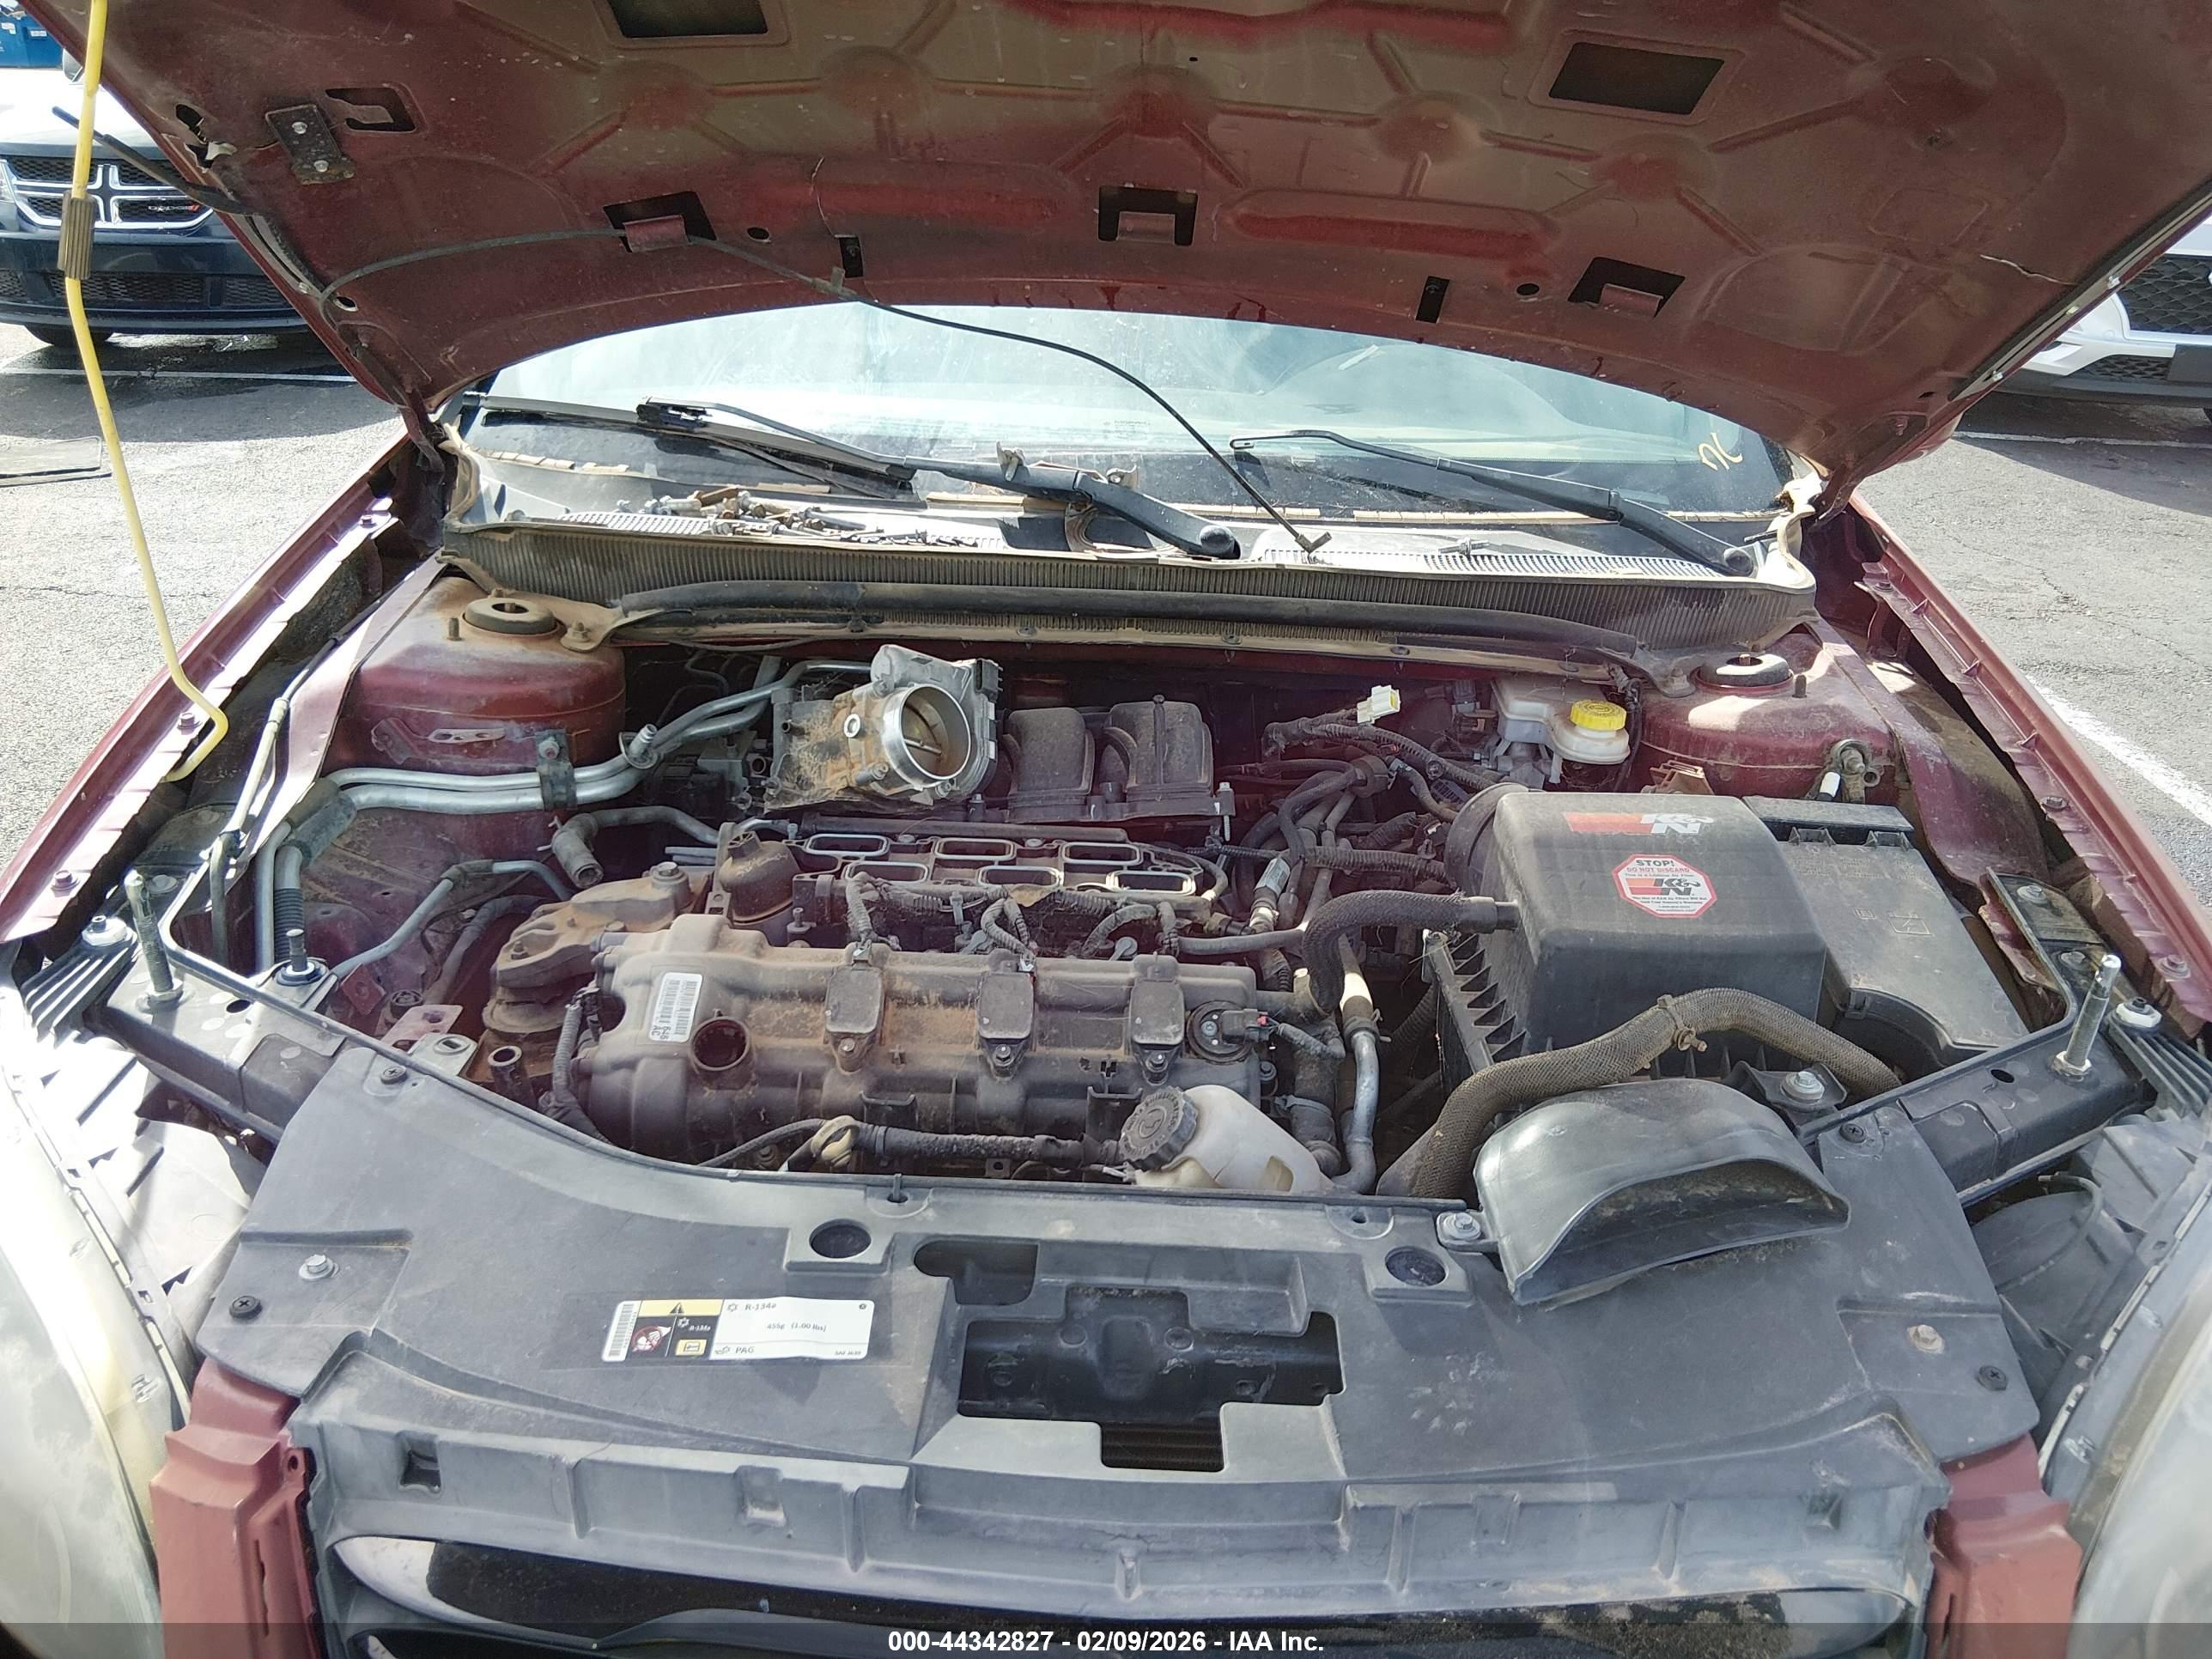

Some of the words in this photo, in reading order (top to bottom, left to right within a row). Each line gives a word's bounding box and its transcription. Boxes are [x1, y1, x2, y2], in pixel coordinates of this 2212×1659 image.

[1654, 878, 1701, 896] K&N
[744, 1303, 777, 1311] R-134a
[735, 1346, 756, 1354] PAG
